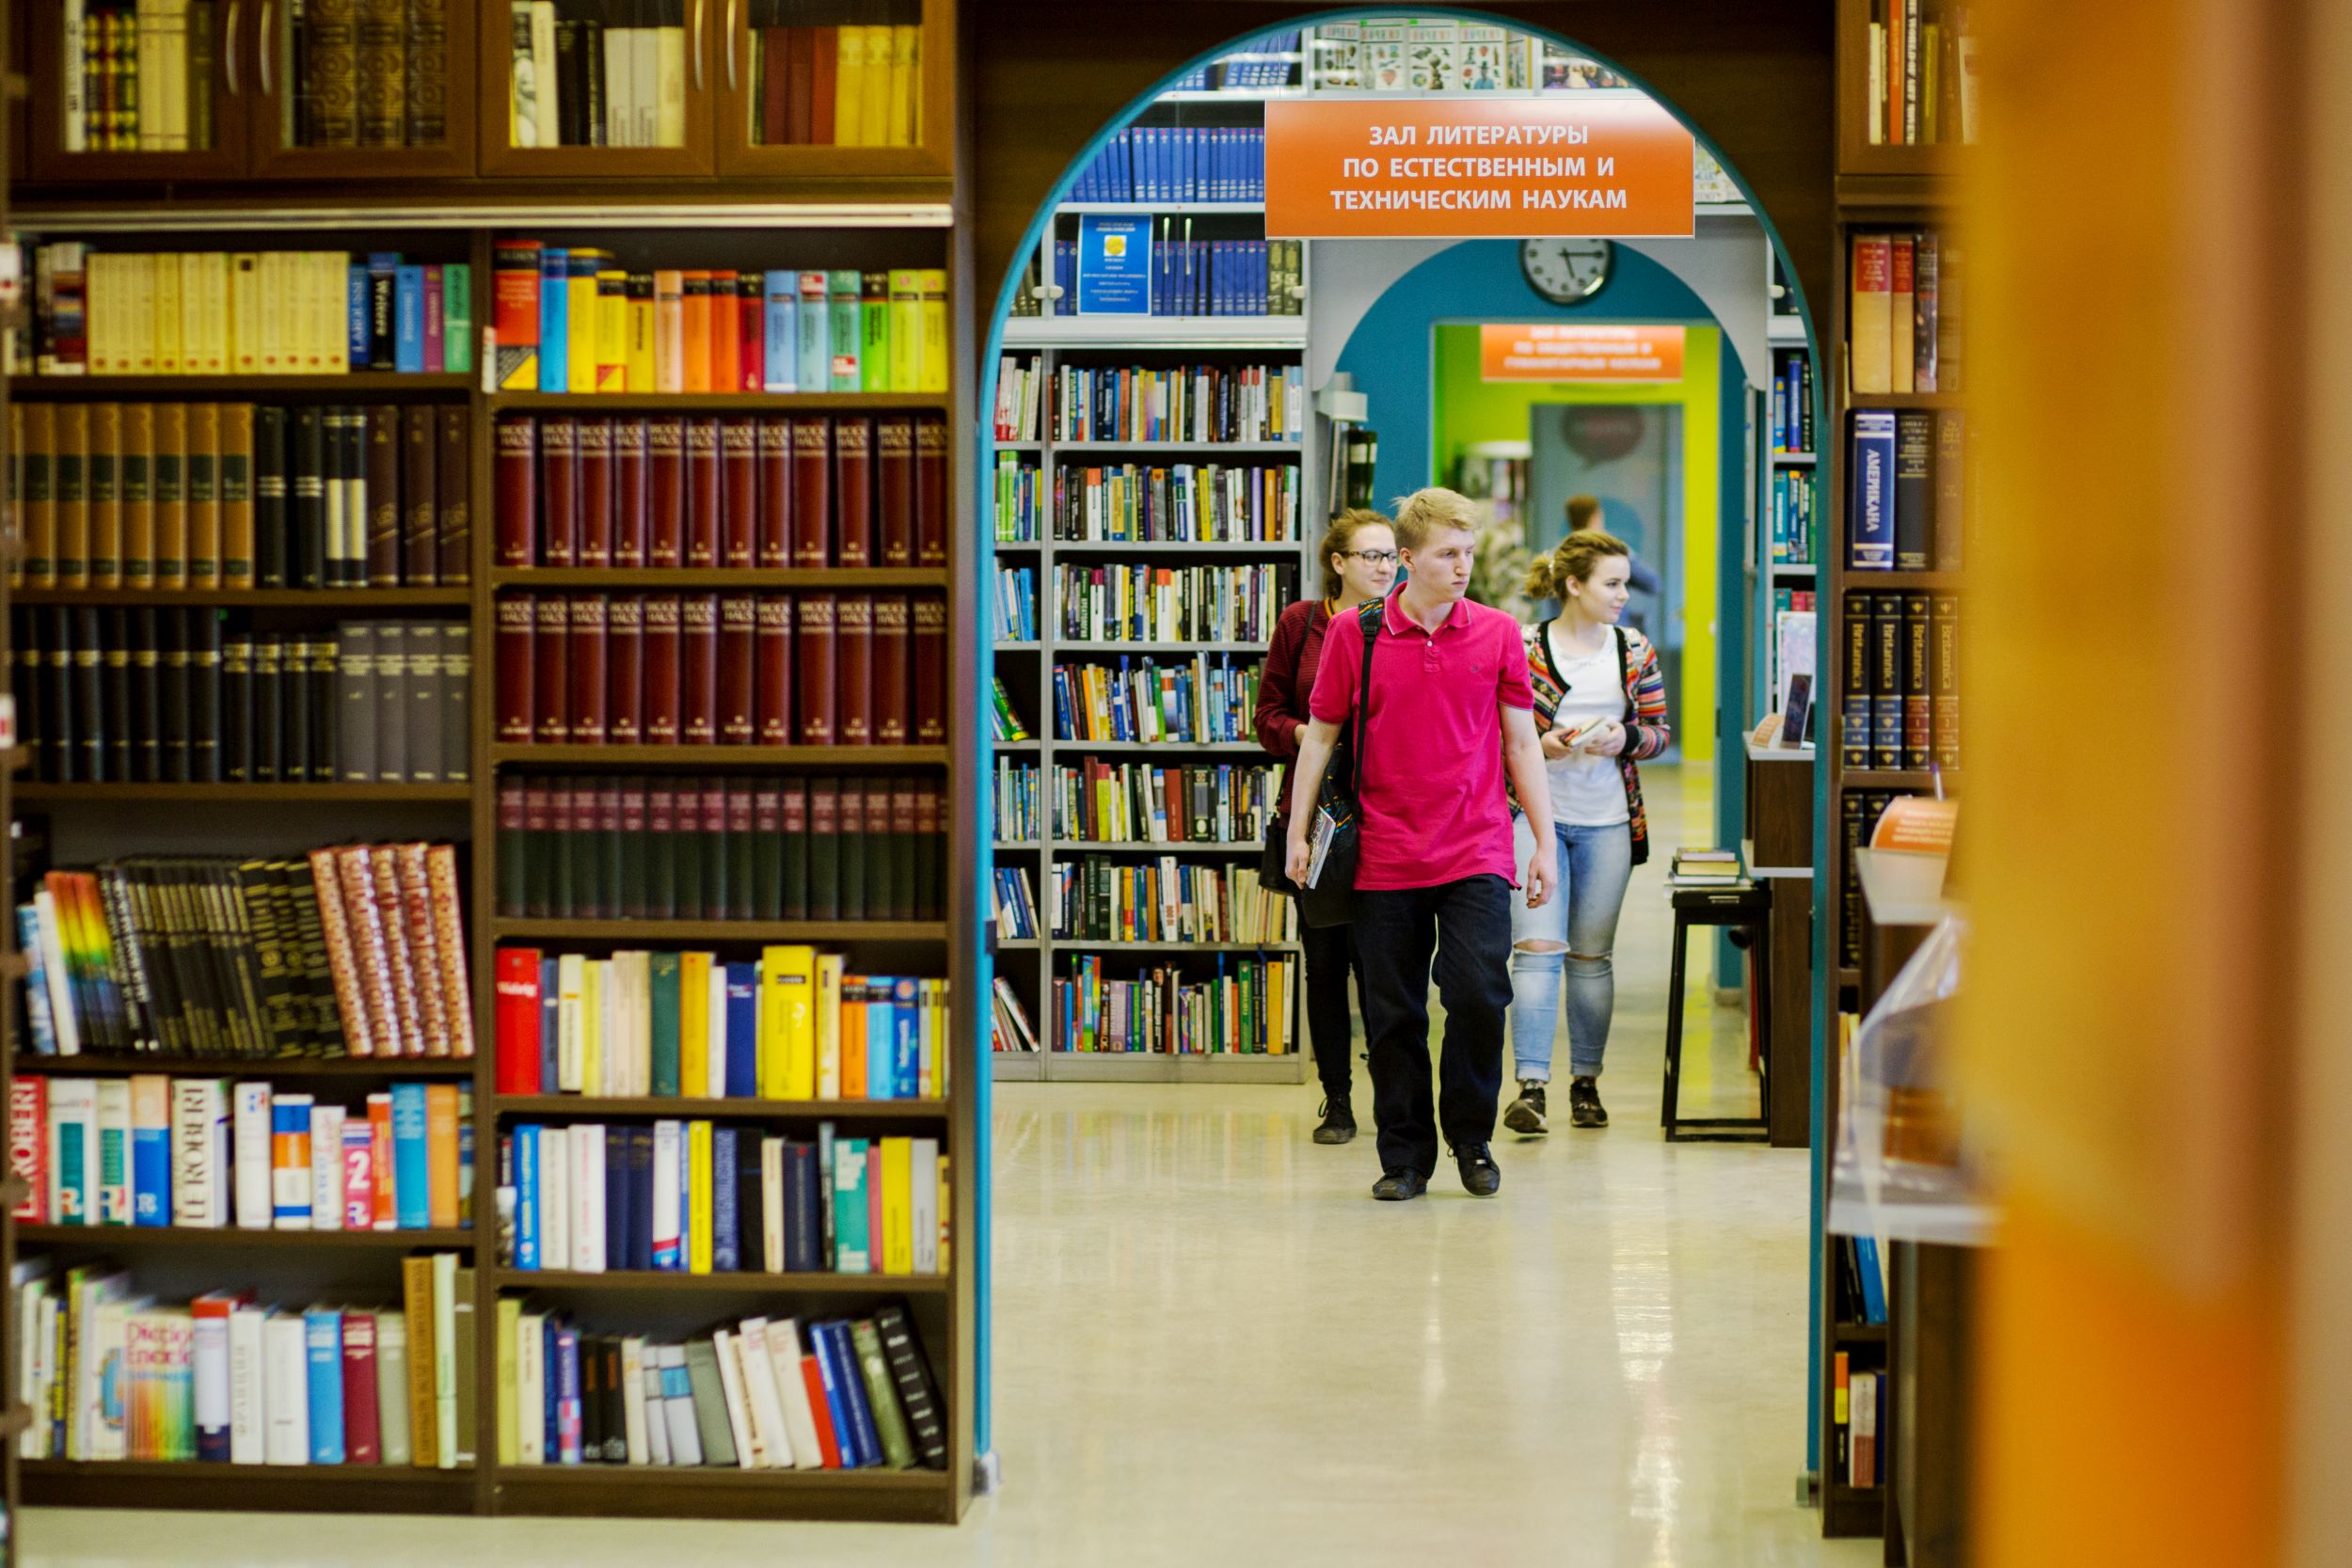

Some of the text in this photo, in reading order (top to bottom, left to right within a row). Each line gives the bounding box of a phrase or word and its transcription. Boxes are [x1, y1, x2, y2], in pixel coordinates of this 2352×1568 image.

[1343, 157, 1614, 178] ПО ЕСТЕСТВЕННЫМ И
[1369, 125, 1588, 146] ЗАЛ ЛИТЕРАТУРЫ
[1330, 190, 1628, 210] ТЕХНИЧЕСКИМ НАУКАМ
[1866, 449, 1881, 532] АМЕРИКАНА
[1851, 623, 1865, 689] Britannica
[1882, 623, 1895, 689] Britannica
[1912, 623, 1925, 689] Britannica
[1941, 624, 1953, 689] Britannica
[183, 1086, 206, 1185] ROBERT
[347, 1149, 372, 1191] 2
